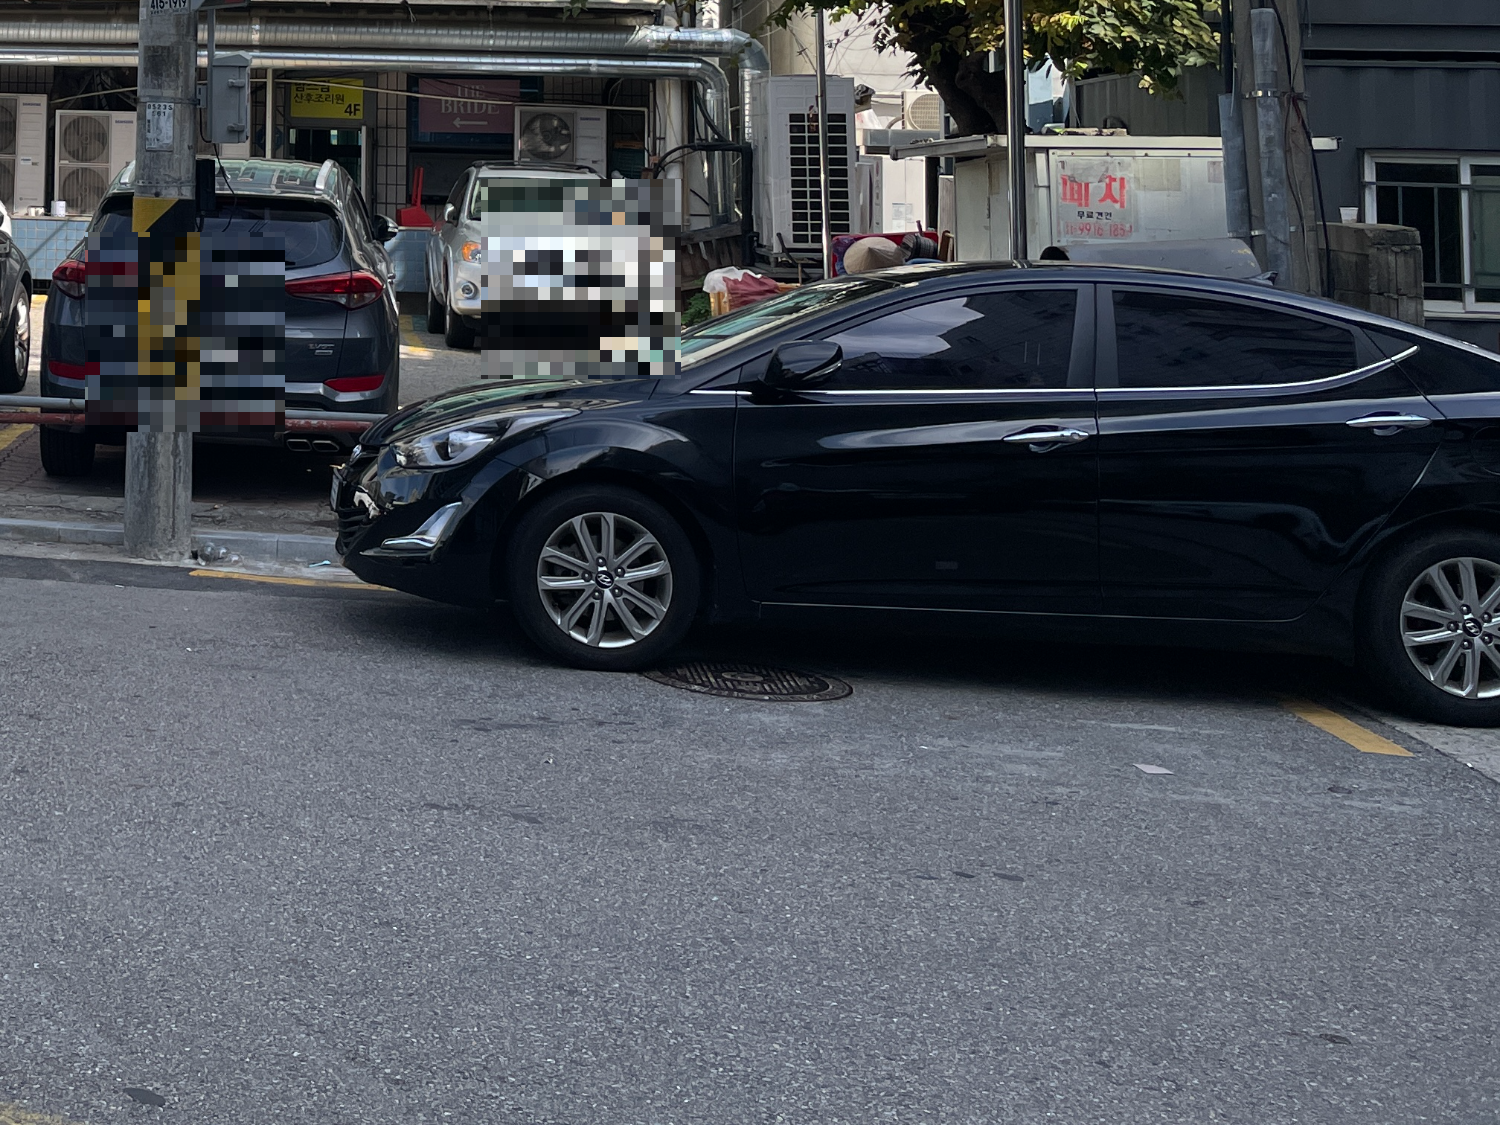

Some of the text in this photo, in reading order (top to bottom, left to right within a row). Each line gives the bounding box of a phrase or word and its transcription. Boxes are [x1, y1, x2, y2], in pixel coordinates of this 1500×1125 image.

[455, 84, 485, 97] THE
[293, 93, 345, 105] 산후조리원
[344, 103, 361, 117] 4F
[440, 98, 500, 114] BRIDE
